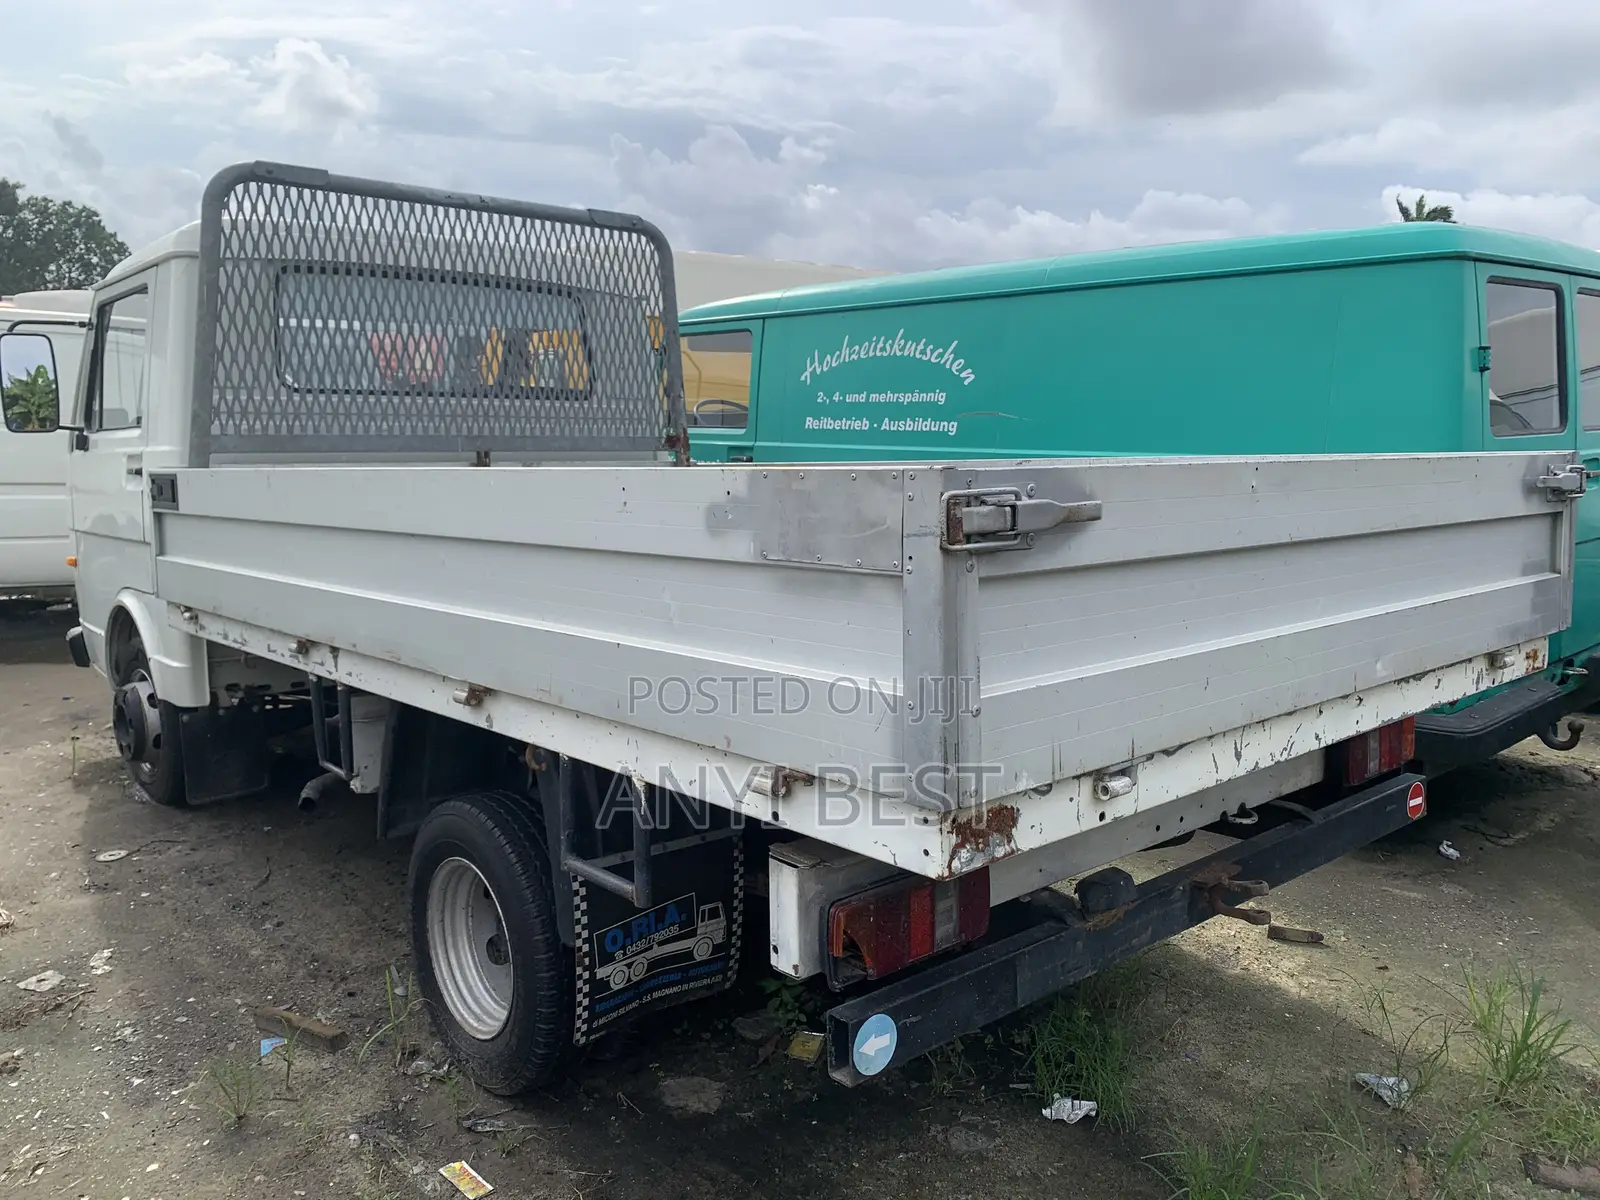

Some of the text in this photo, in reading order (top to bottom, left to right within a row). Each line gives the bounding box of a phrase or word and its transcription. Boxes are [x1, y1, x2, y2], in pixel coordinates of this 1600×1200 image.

[800, 328, 976, 386] Hochzeitskutschen
[846, 391, 866, 403] und
[869, 389, 946, 405] mehrspännig
[805, 416, 869, 430] Reitbetrieb
[881, 416, 958, 436] Ausbildung
[652, 984, 682, 1000] MAGNANO
